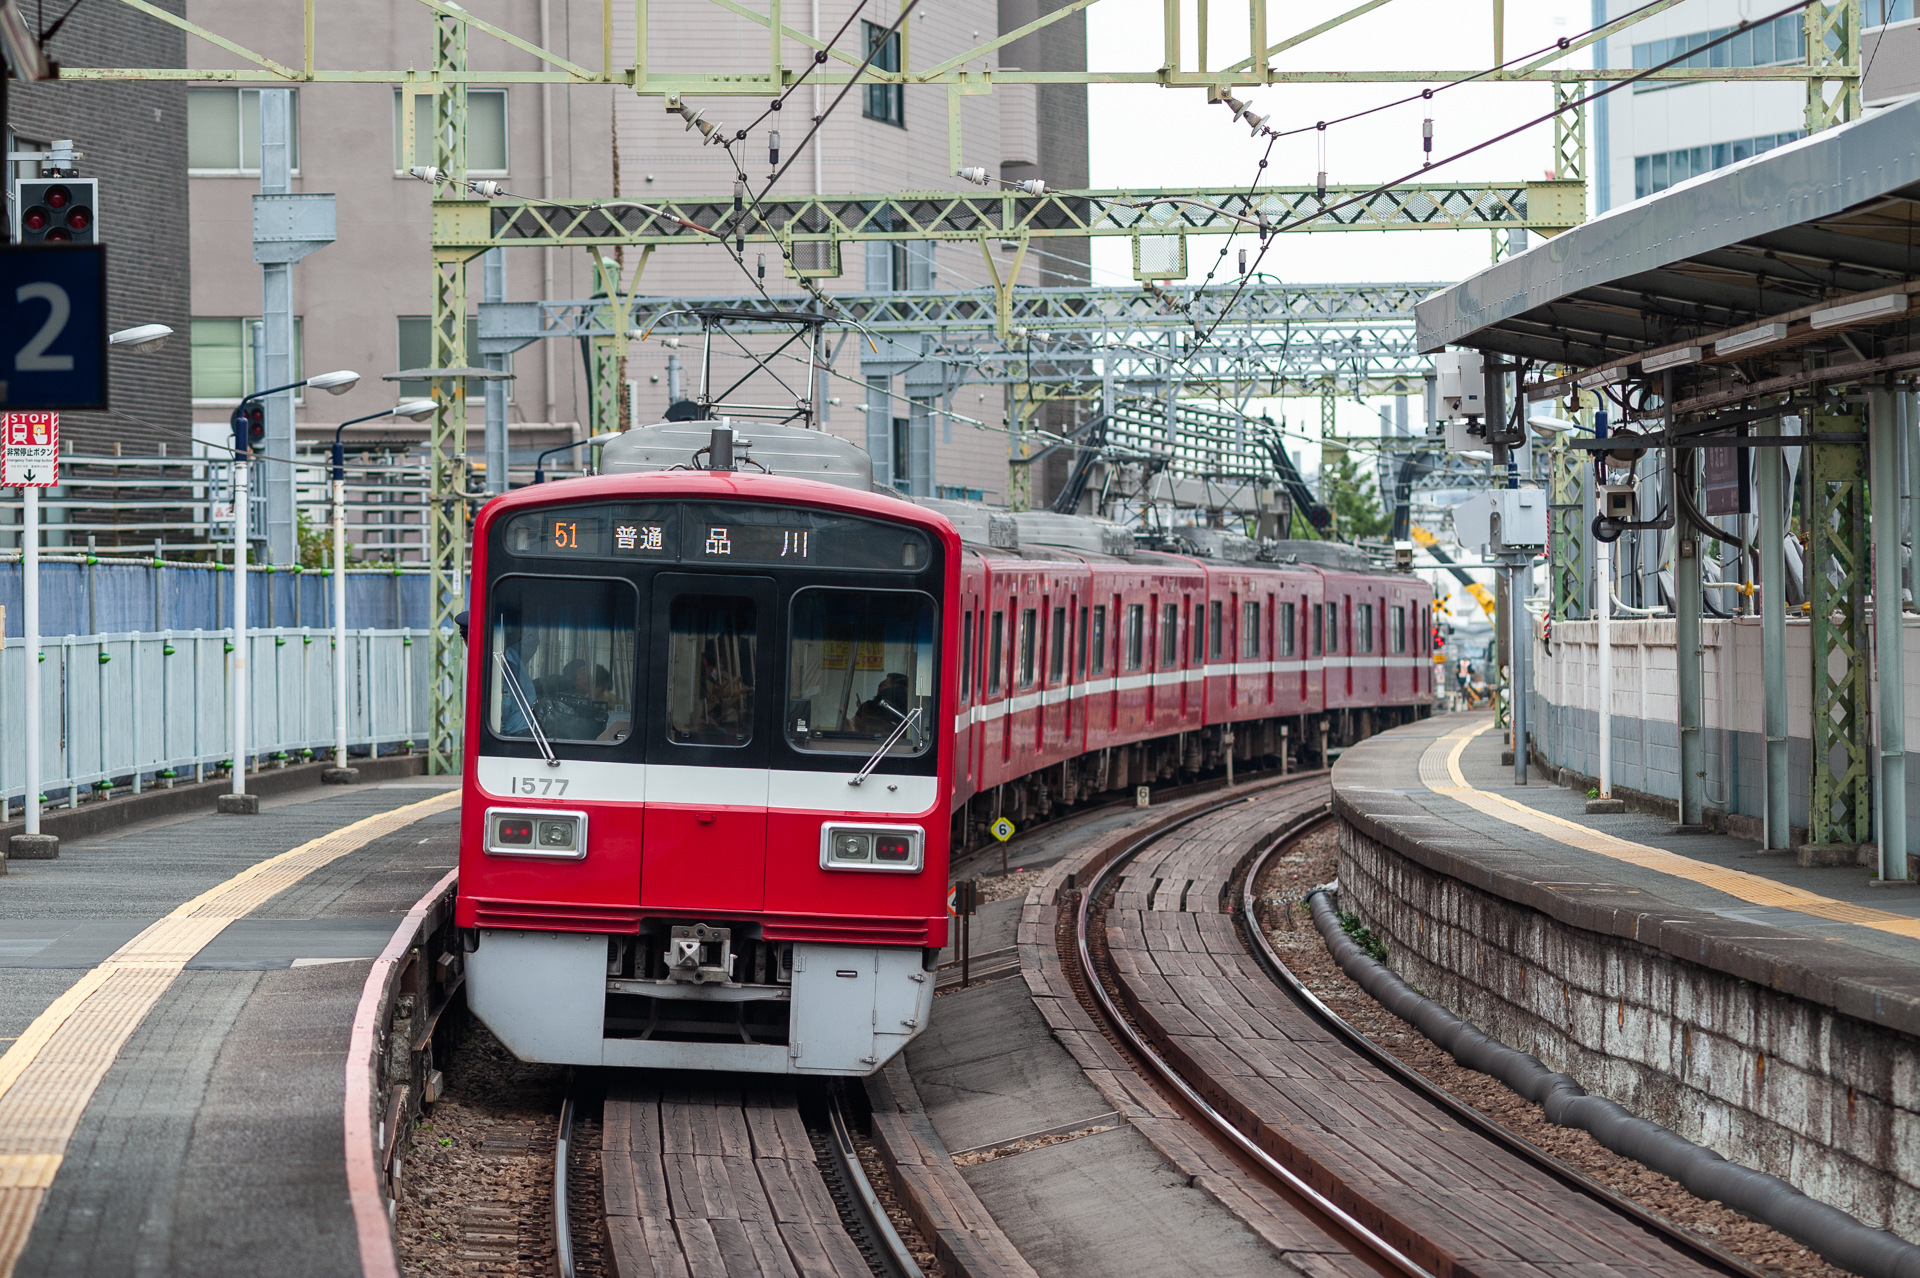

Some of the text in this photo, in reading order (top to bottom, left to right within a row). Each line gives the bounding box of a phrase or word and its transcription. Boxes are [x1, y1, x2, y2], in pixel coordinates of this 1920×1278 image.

[14, 281, 74, 371] 2
[11, 413, 49, 424] STOP
[7, 447, 53, 457] 非常停止ボタン
[555, 522, 578, 548] 51
[615, 525, 663, 550] 普通
[705, 527, 808, 558] 品川
[512, 776, 569, 796] 1577
[999, 823, 1007, 835] 6
